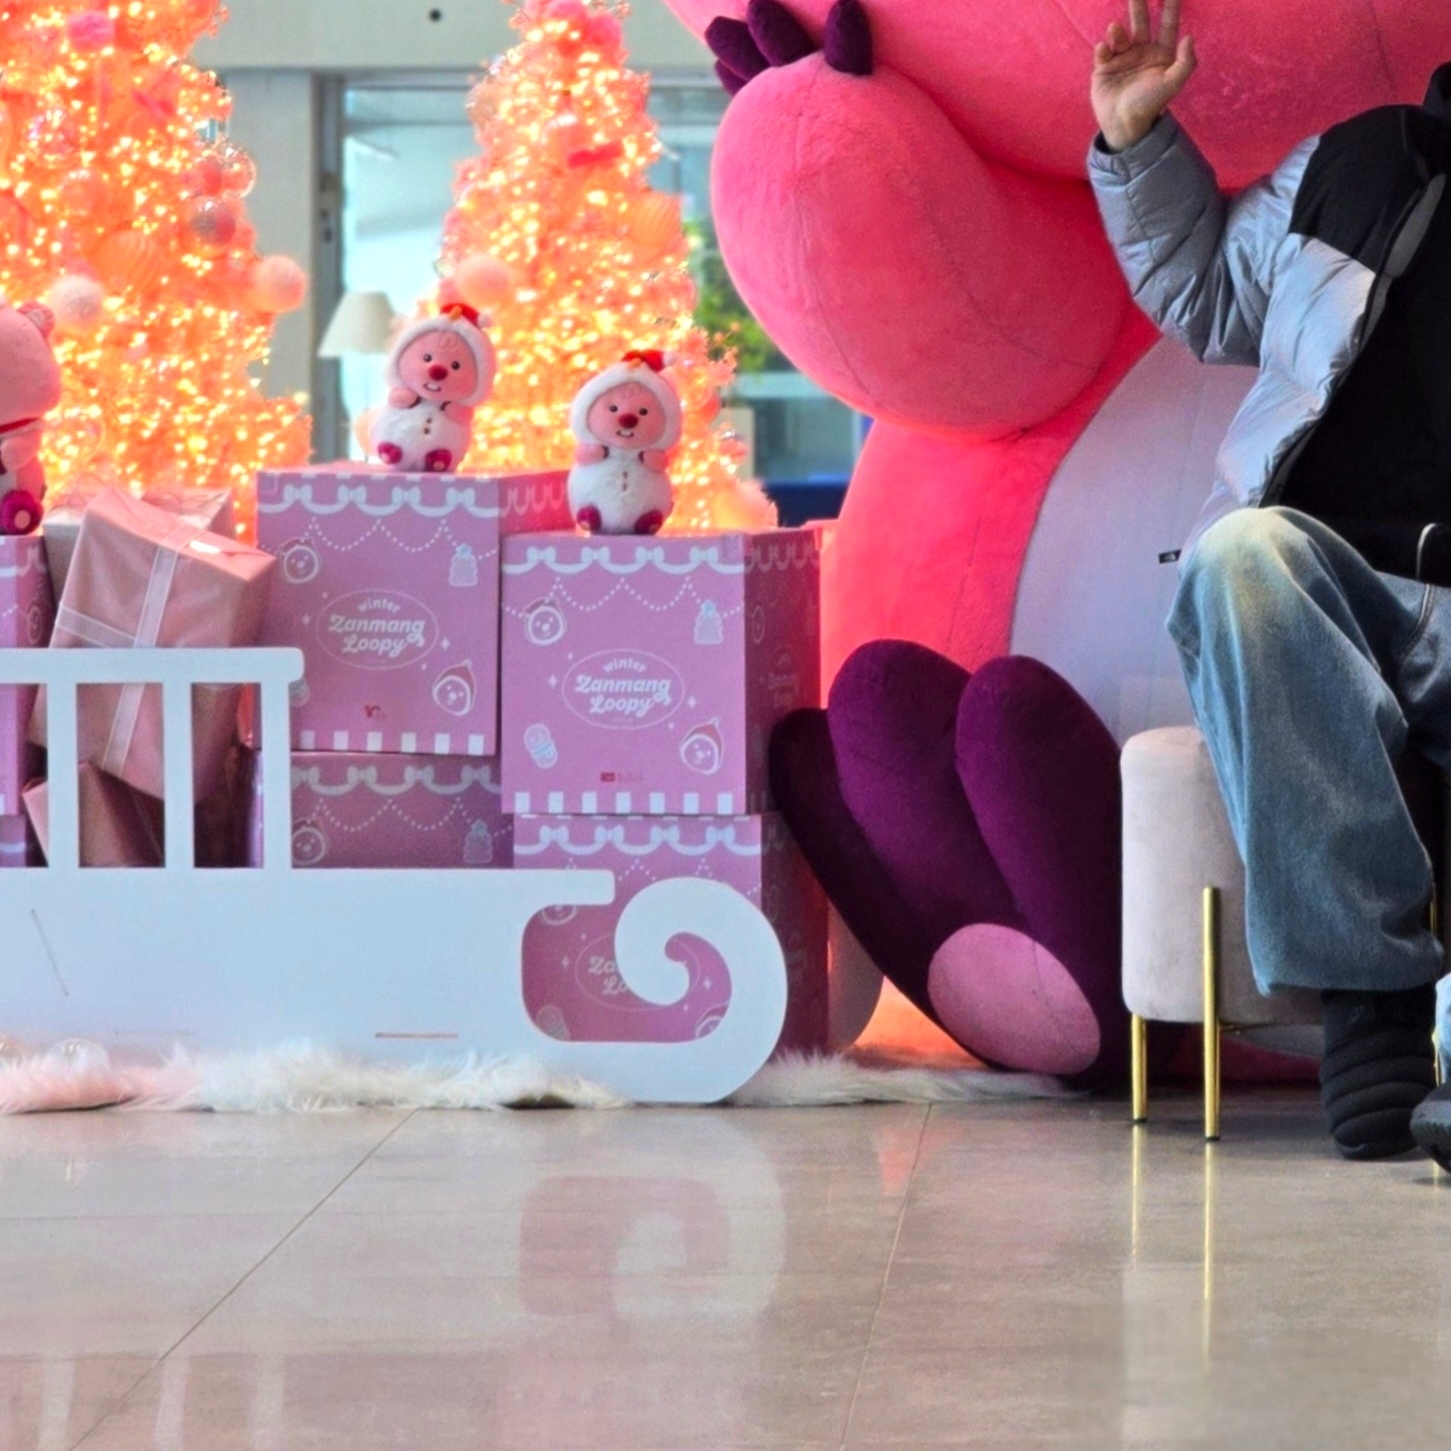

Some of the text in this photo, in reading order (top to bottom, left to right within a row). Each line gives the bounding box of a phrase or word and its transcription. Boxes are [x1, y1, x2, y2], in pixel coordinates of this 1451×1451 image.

[358, 597, 401, 613] winter
[328, 614, 426, 648] Zanmang
[341, 633, 405, 658] Loopy
[603, 657, 647, 673] winter
[574, 674, 672, 706] Zanmang
[589, 693, 654, 718] Loopy
